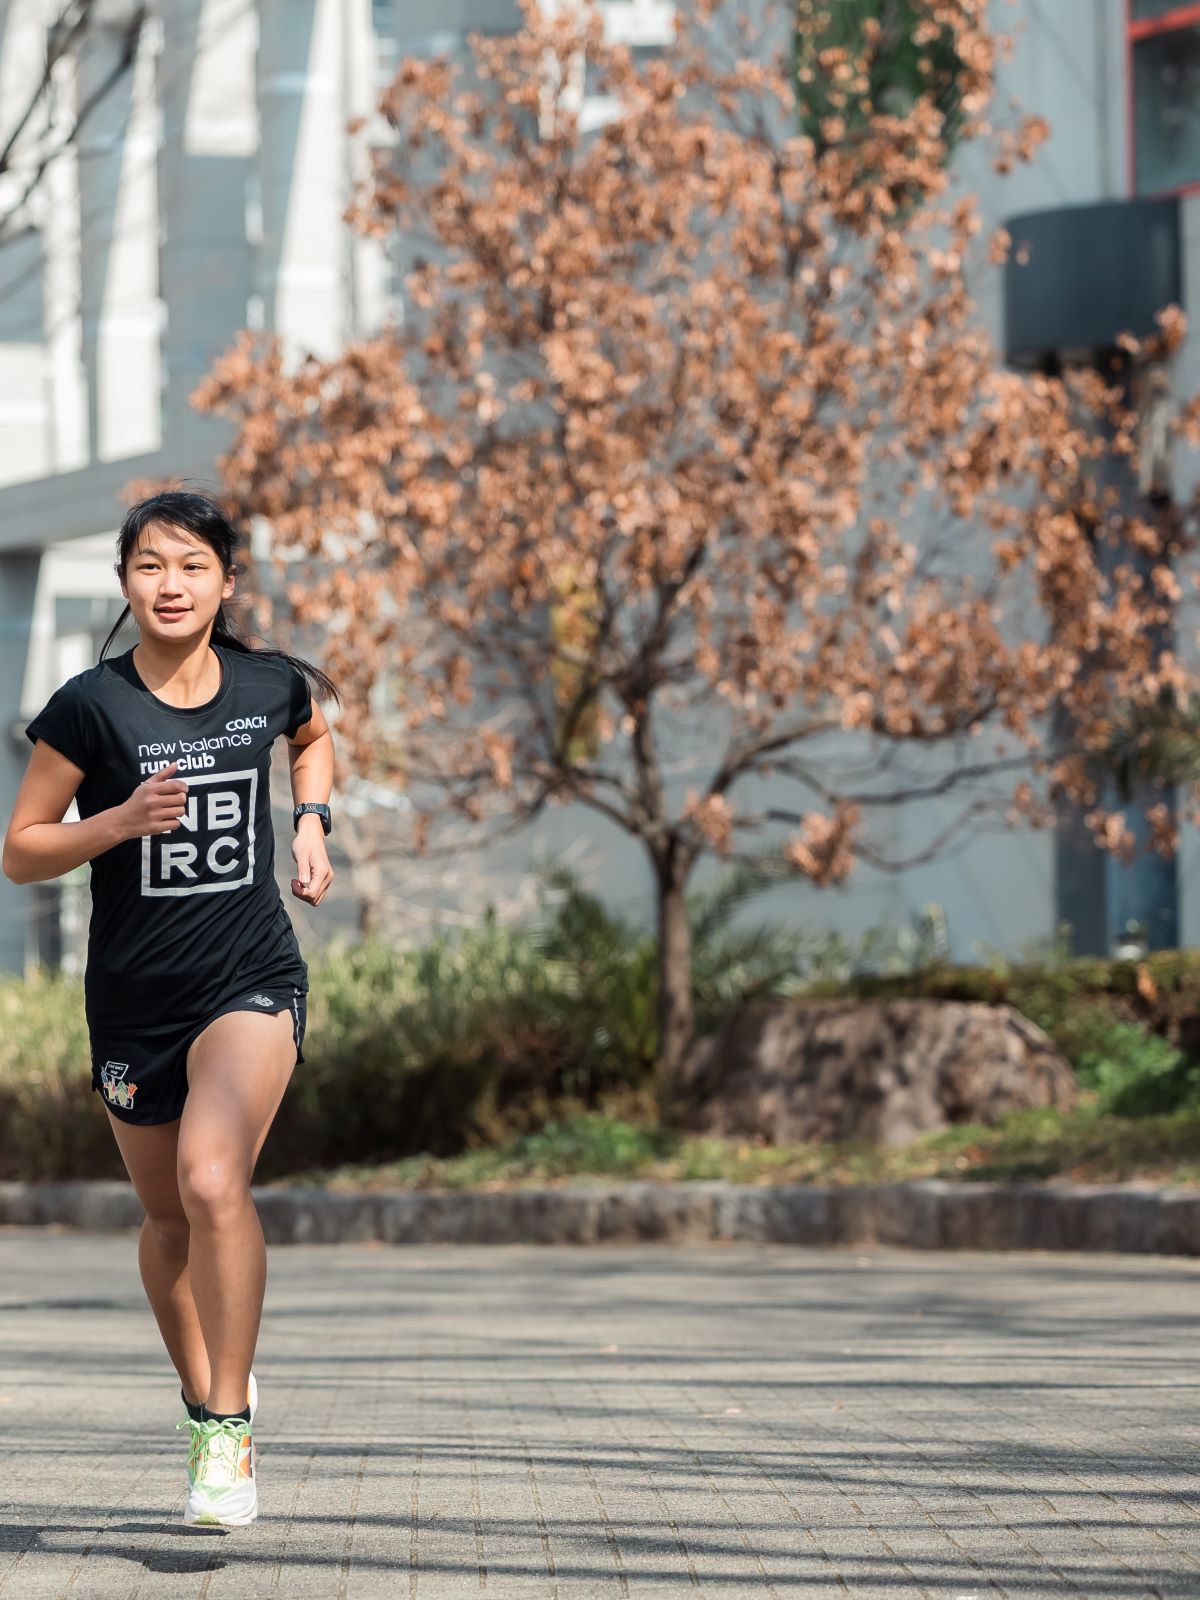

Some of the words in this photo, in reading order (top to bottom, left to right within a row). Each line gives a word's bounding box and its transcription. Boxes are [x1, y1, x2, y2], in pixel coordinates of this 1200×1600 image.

[225, 715, 267, 732] COACH
[138, 743, 176, 757] new
[179, 733, 252, 753] balance
[140, 759, 170, 775] run
[176, 752, 216, 771] club
[161, 836, 241, 880] RC
